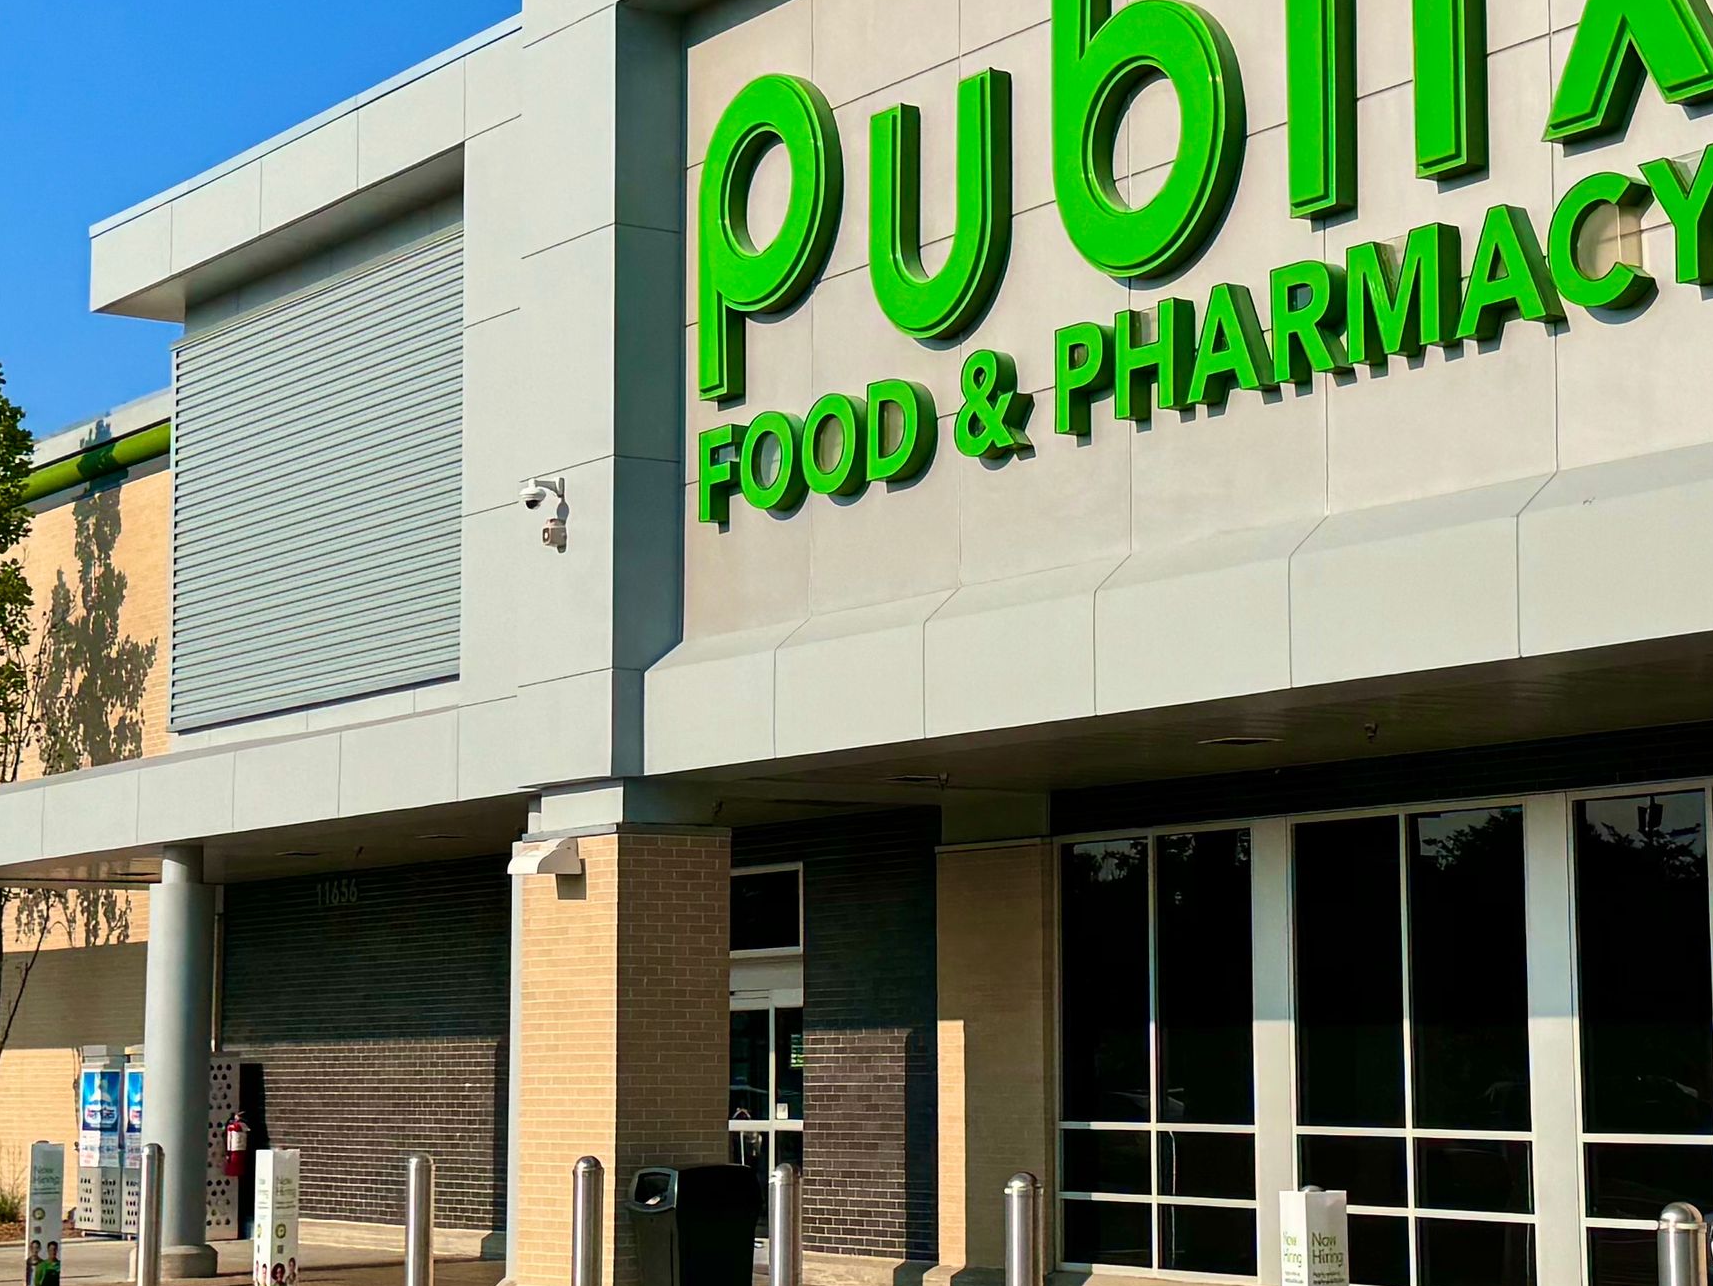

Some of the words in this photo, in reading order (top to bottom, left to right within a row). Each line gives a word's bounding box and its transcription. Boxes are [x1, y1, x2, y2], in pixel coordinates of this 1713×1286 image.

[699, 378, 936, 523] FOOD
[953, 348, 1034, 460] &
[1312, 1232, 1337, 1247] Now
[1312, 1248, 1344, 1267] Hiring
